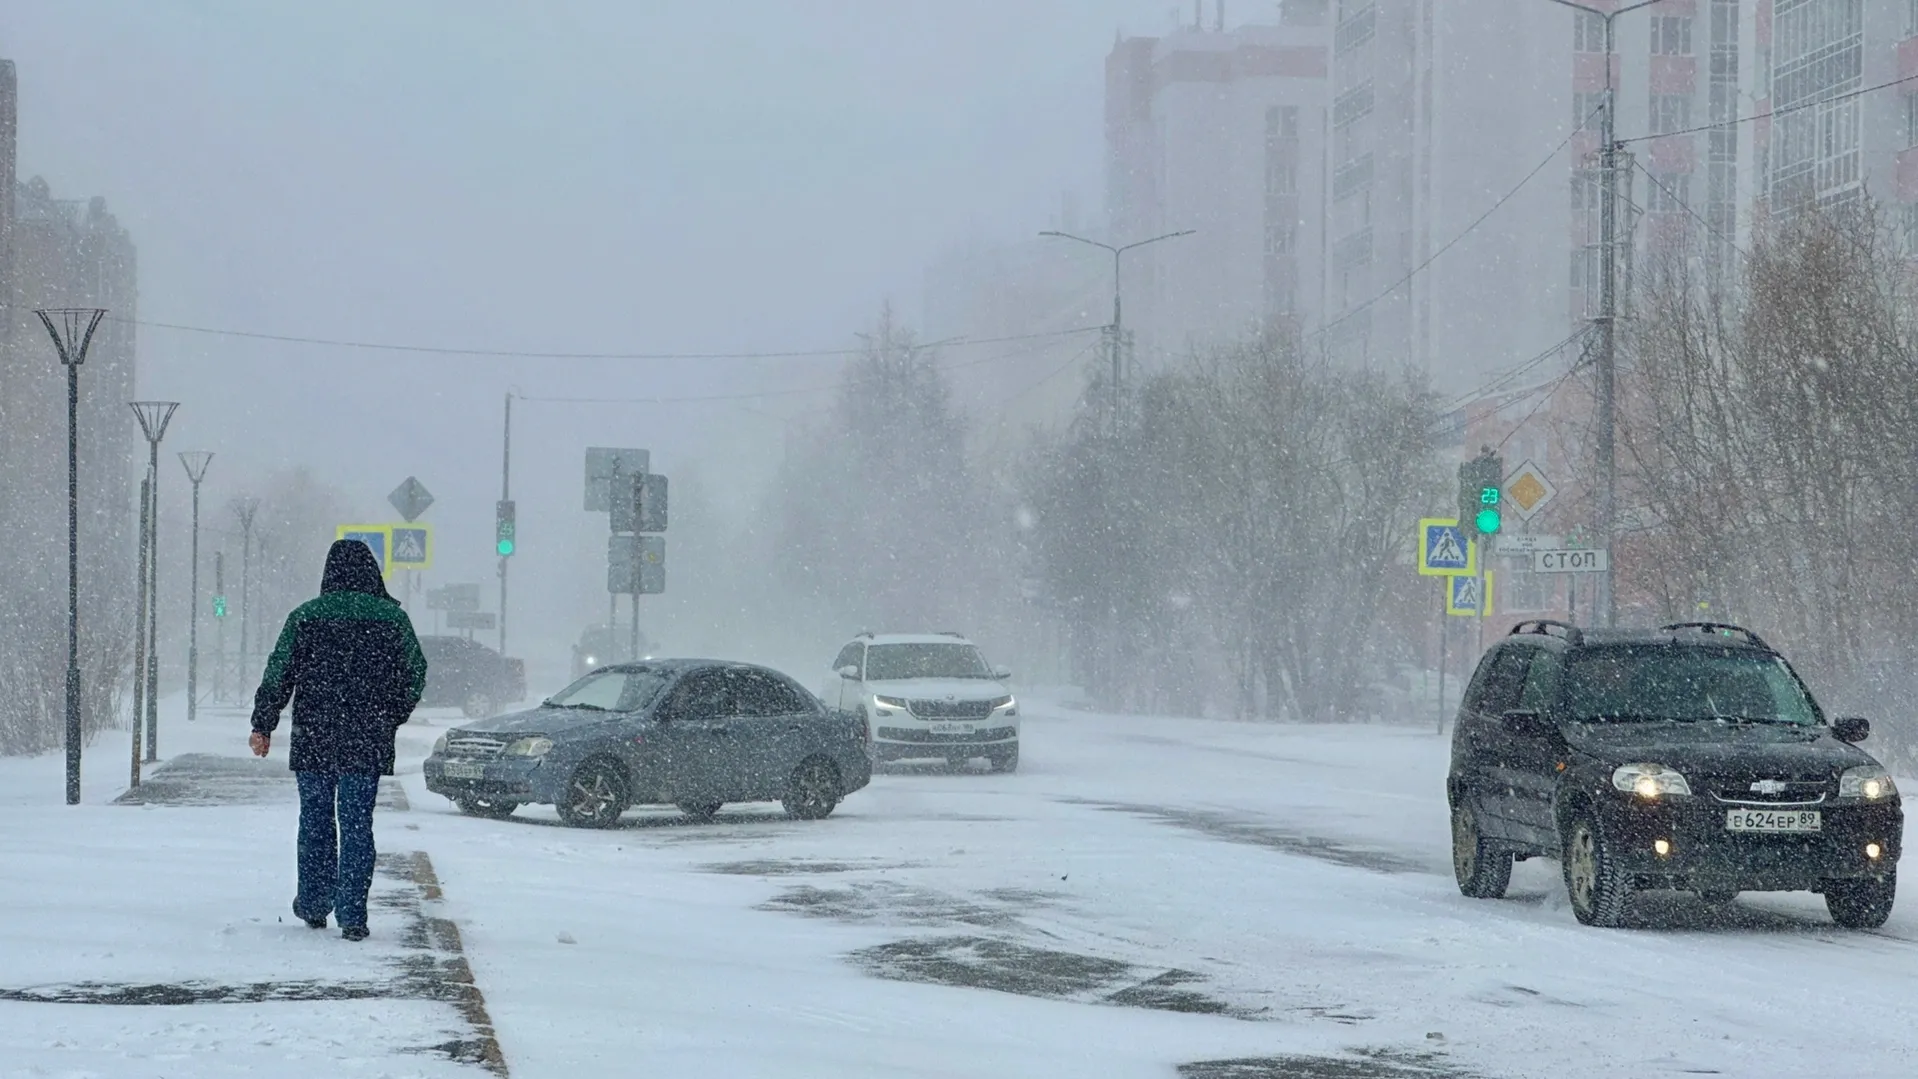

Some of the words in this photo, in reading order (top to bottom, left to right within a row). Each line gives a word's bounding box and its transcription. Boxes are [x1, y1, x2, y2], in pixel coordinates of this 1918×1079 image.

[1481, 488, 1498, 504] 23
[1542, 552, 1596, 568] СТОП
[1800, 812, 1815, 824] 89
